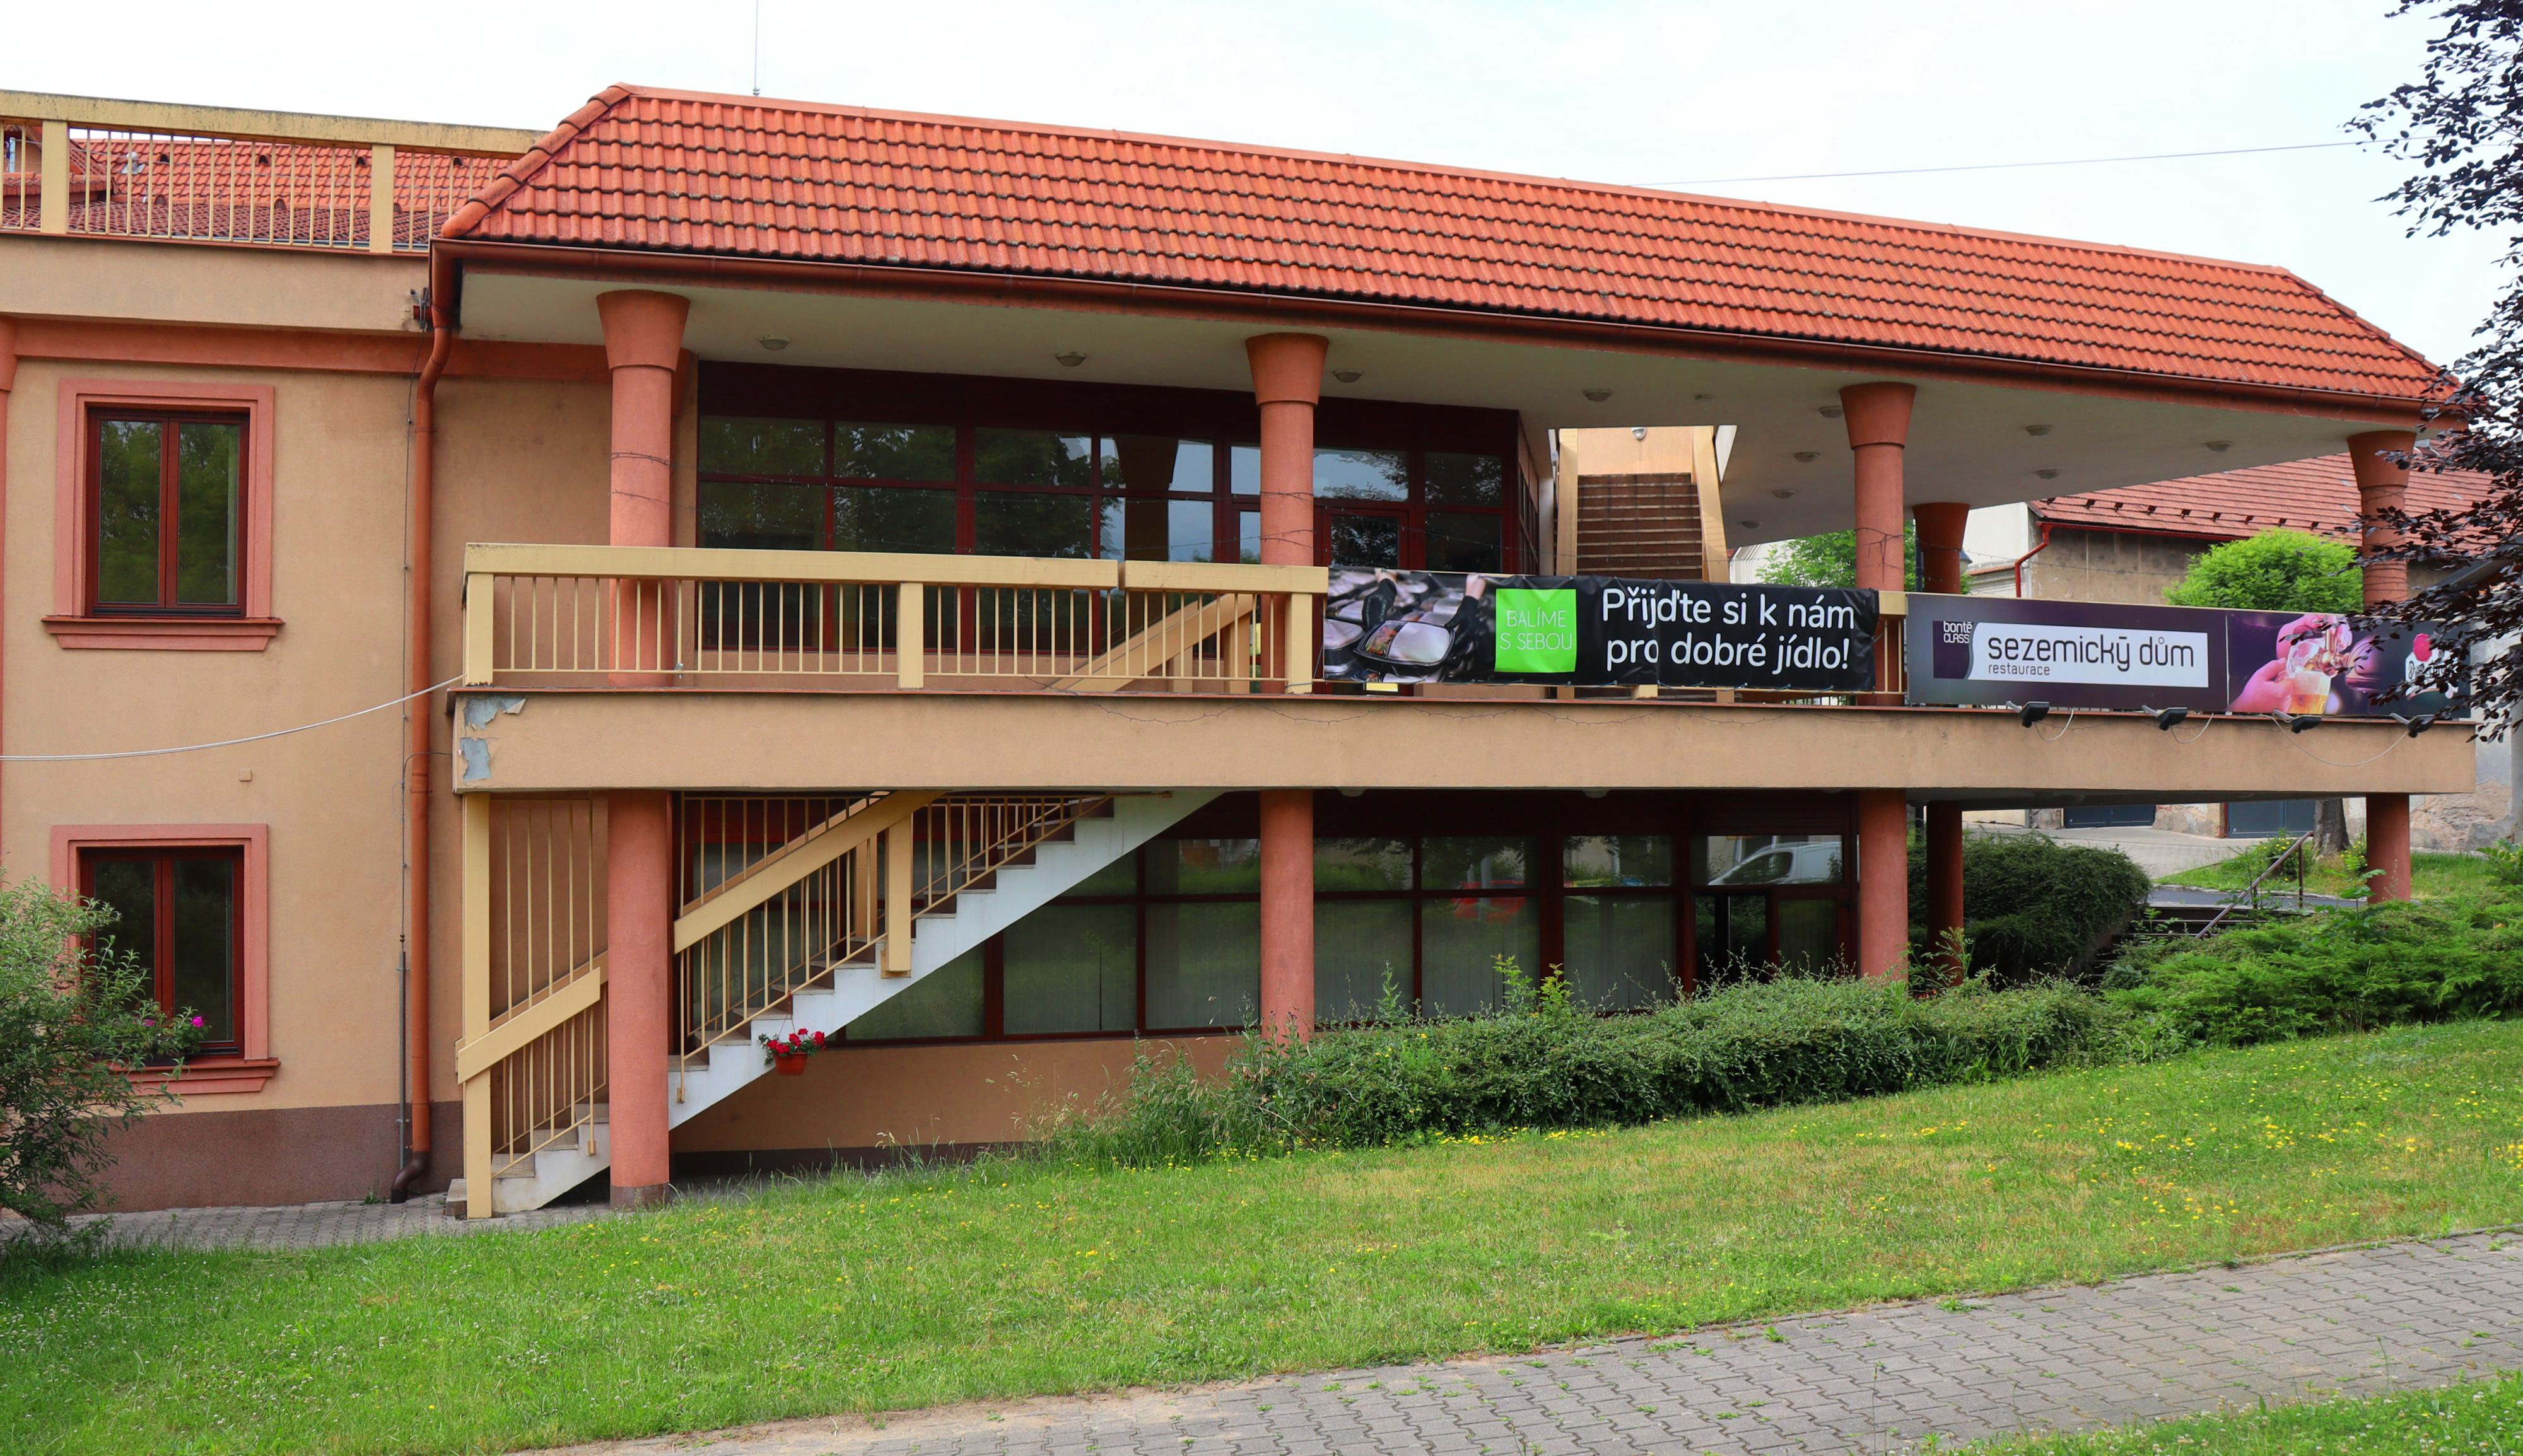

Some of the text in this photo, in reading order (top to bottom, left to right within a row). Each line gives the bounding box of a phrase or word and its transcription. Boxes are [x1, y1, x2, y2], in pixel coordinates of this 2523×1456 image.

[1506, 606, 1567, 627] BALÍME
[1602, 586, 1854, 629] Přijďte si k nám
[1499, 632, 1572, 650] S SEBOU
[1943, 633, 1970, 644] CLASS
[1607, 632, 1850, 675] pro dobré jídlo!
[2139, 636, 2194, 667] dům
[1988, 663, 2051, 676] restaurace
